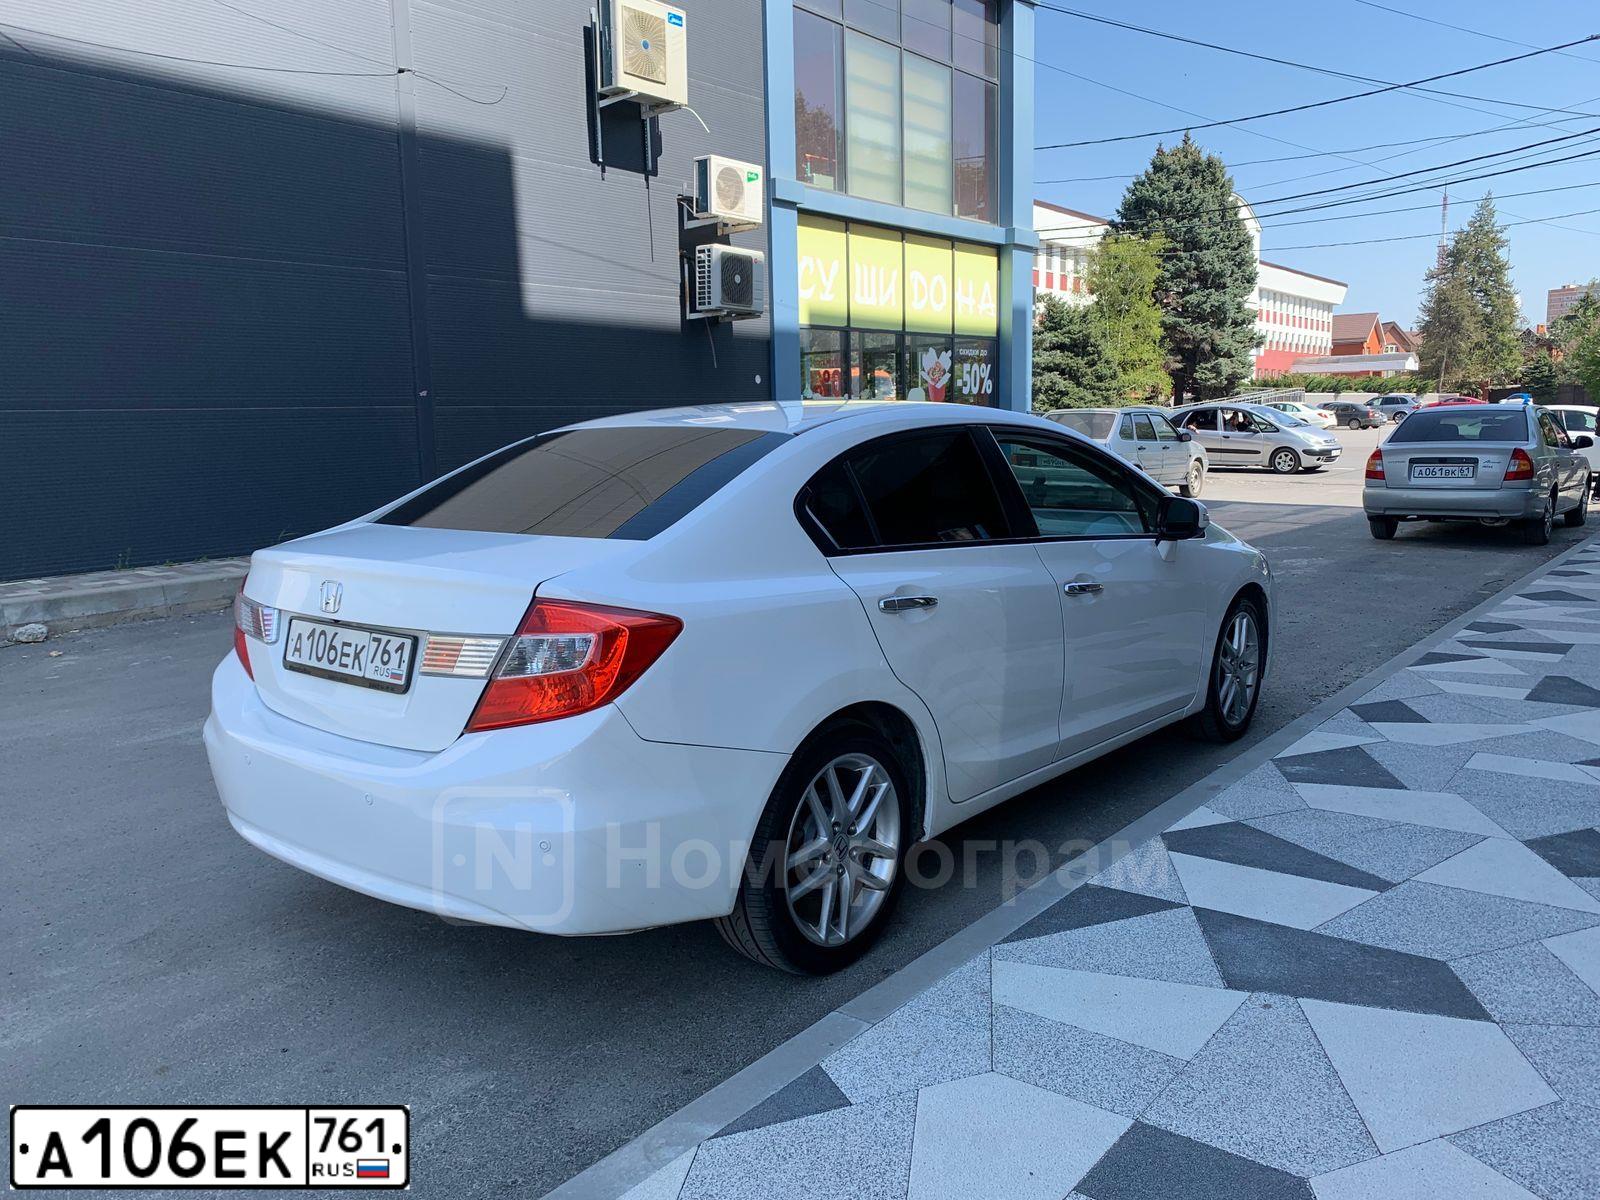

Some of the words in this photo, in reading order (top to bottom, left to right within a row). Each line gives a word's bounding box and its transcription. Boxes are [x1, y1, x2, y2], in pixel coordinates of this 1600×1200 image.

[956, 363, 993, 395] -50%
[370, 636, 406, 669] 761
[374, 665, 391, 678] RUS
